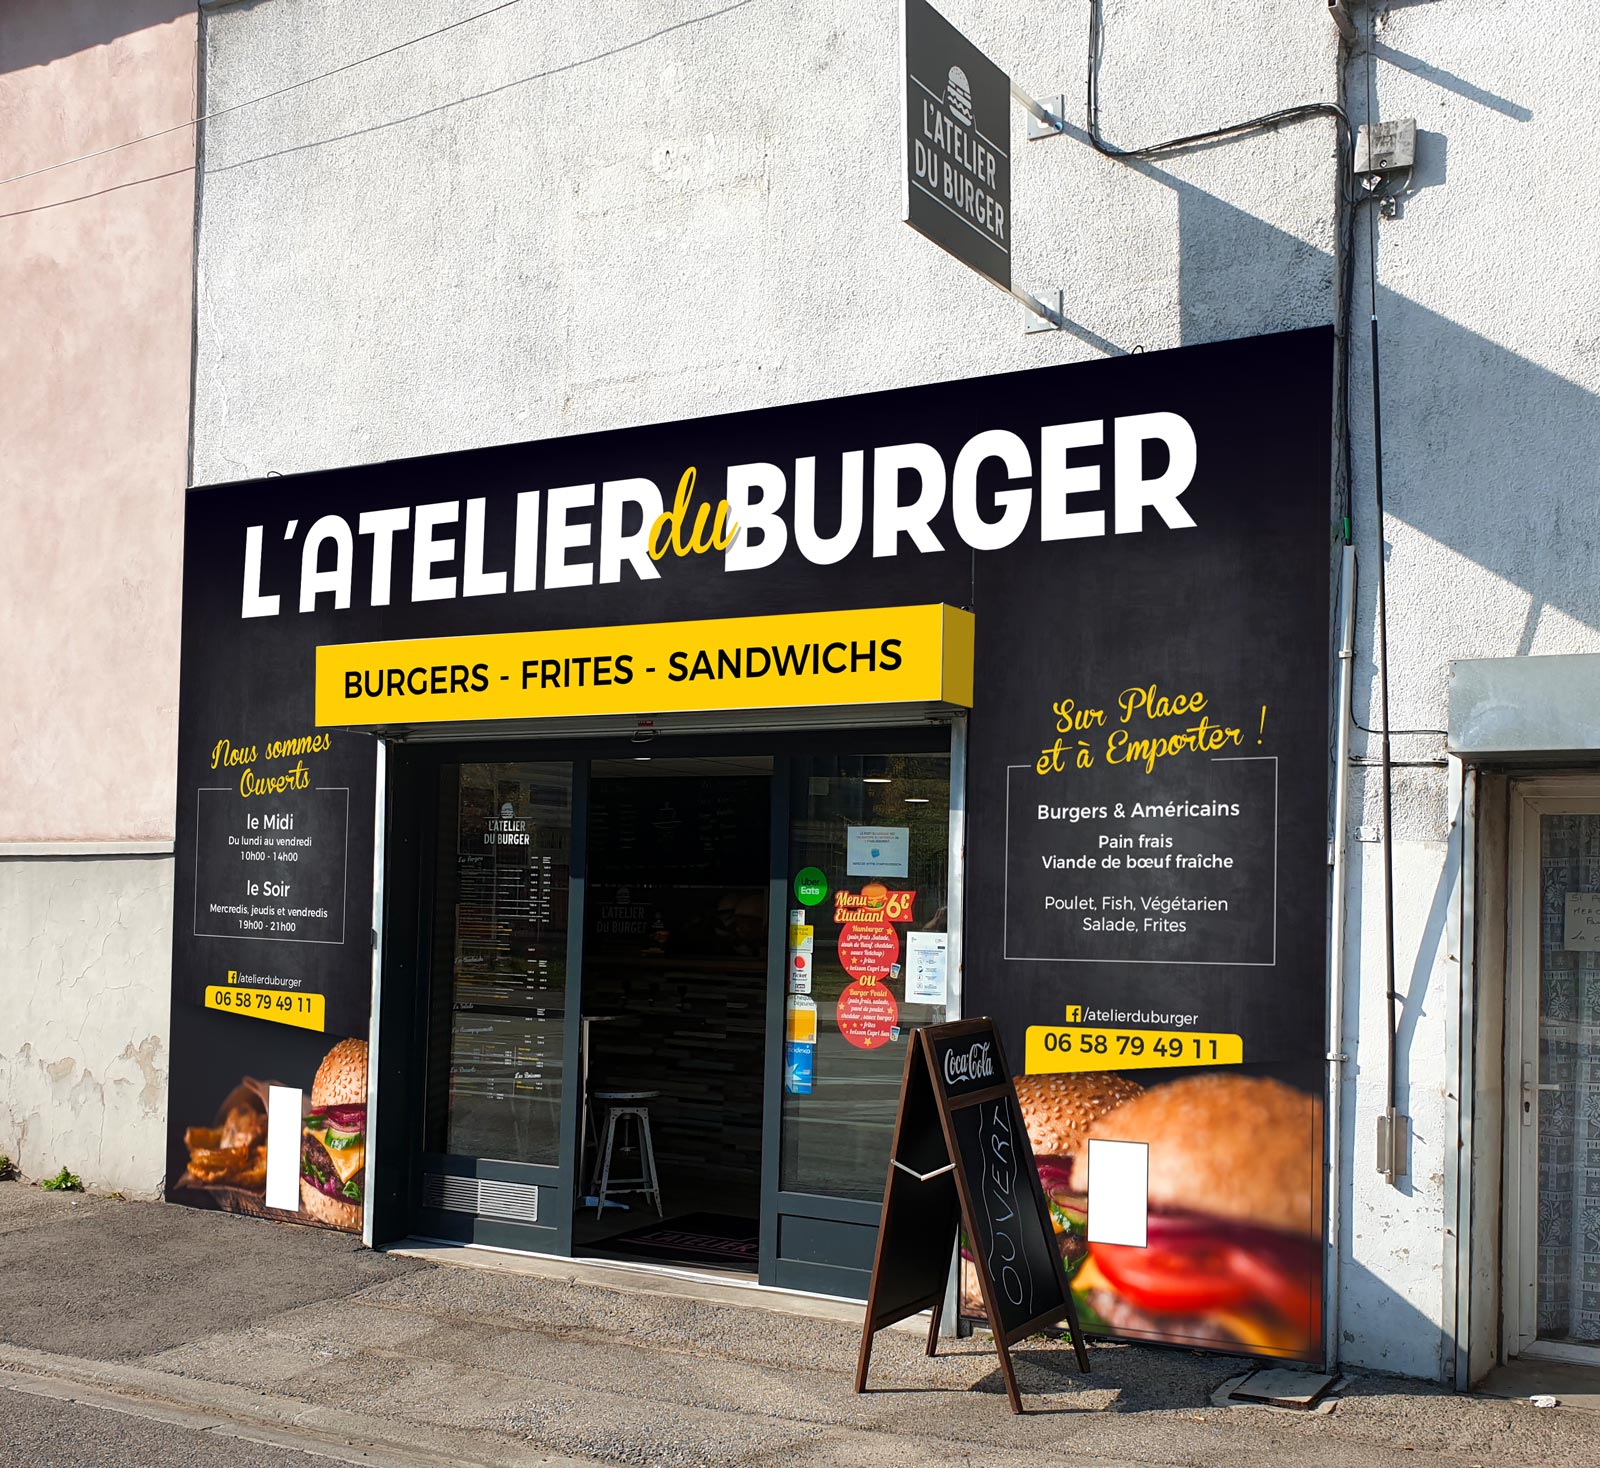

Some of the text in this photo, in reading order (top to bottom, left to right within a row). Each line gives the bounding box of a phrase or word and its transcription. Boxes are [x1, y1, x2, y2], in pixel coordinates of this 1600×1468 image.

[923, 98, 996, 190] L'ATELIER
[915, 139, 1004, 239] DU BURGER
[242, 411, 1197, 619] L'ATELIER du BURGER
[345, 664, 488, 698] BURGERS
[523, 655, 633, 689] FRITES
[668, 639, 901, 681] SANDWICHS
[1053, 684, 1208, 732] Sur Place
[211, 734, 331, 768] Nous sommes
[1036, 737, 1068, 775] et
[1077, 741, 1094, 768] à
[1106, 717, 1244, 774] Emporter
[240, 760, 310, 798] Ouverts
[1038, 800, 1239, 822] Burgers & Américains
[248, 814, 293, 829] le Midi
[229, 836, 239, 844] Du
[242, 836, 262, 845] lundi
[276, 837, 311, 846] vendredi
[484, 834, 530, 845] DU BURGER
[1099, 834, 1172, 848] Pain frais
[241, 851, 265, 860] 10h00
[274, 852, 298, 861] 14h00
[1042, 854, 1233, 868] Viande de bœuf fraîche
[247, 880, 290, 896] le Soir
[836, 892, 867, 907] Menu
[886, 894, 910, 918] 6€
[1046, 896, 1227, 913] Poulet, Fish, Végétarien
[210, 904, 327, 917] Mercredis, jeudis et vendredis
[239, 920, 263, 929] 19h00
[271, 922, 295, 931] 21h00
[1083, 917, 1186, 932] Salade, Frites
[216, 991, 310, 1012] 06 58 79 49 11
[849, 989, 868, 997] Burger
[1045, 1033, 1216, 1059] 06 58 79 49 11
[991, 1104, 1022, 1306] OUVERT
